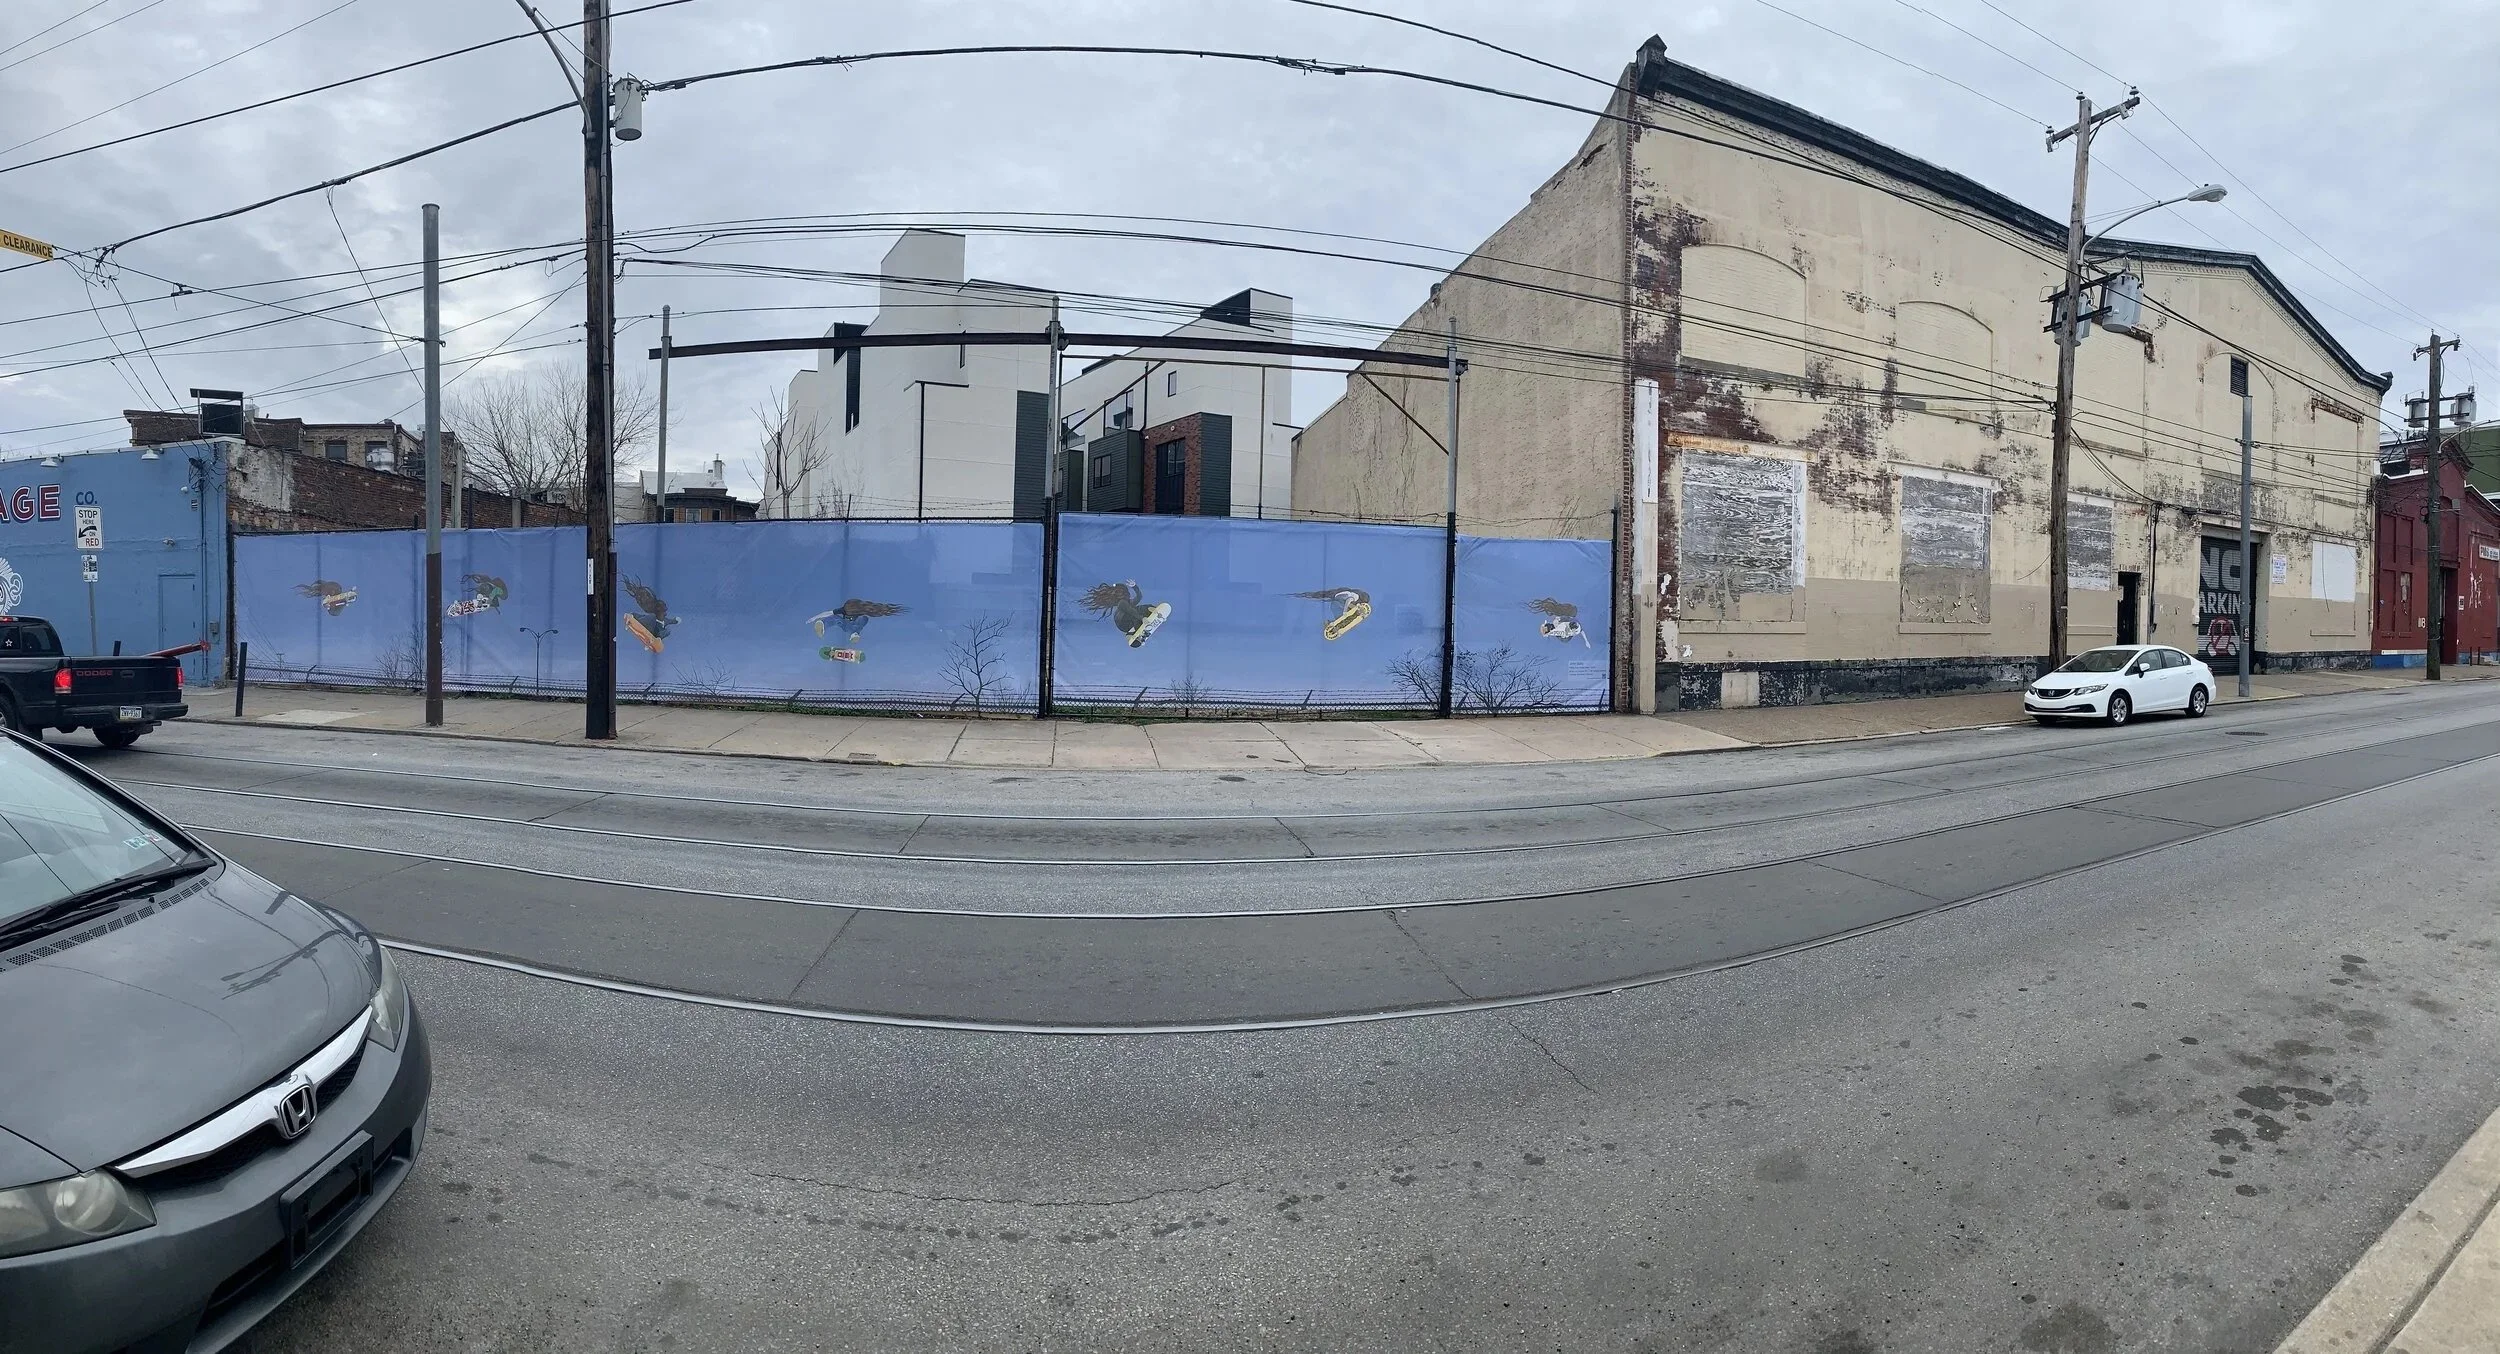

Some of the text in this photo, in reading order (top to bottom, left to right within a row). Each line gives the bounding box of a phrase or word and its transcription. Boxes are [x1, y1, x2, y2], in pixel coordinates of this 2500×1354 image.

[3, 234, 54, 258] CLEARANCE
[76, 491, 98, 505] CO.
[78, 509, 98, 519] STOP
[85, 537, 100, 547] RED
[2199, 592, 2240, 614] ARKIN
